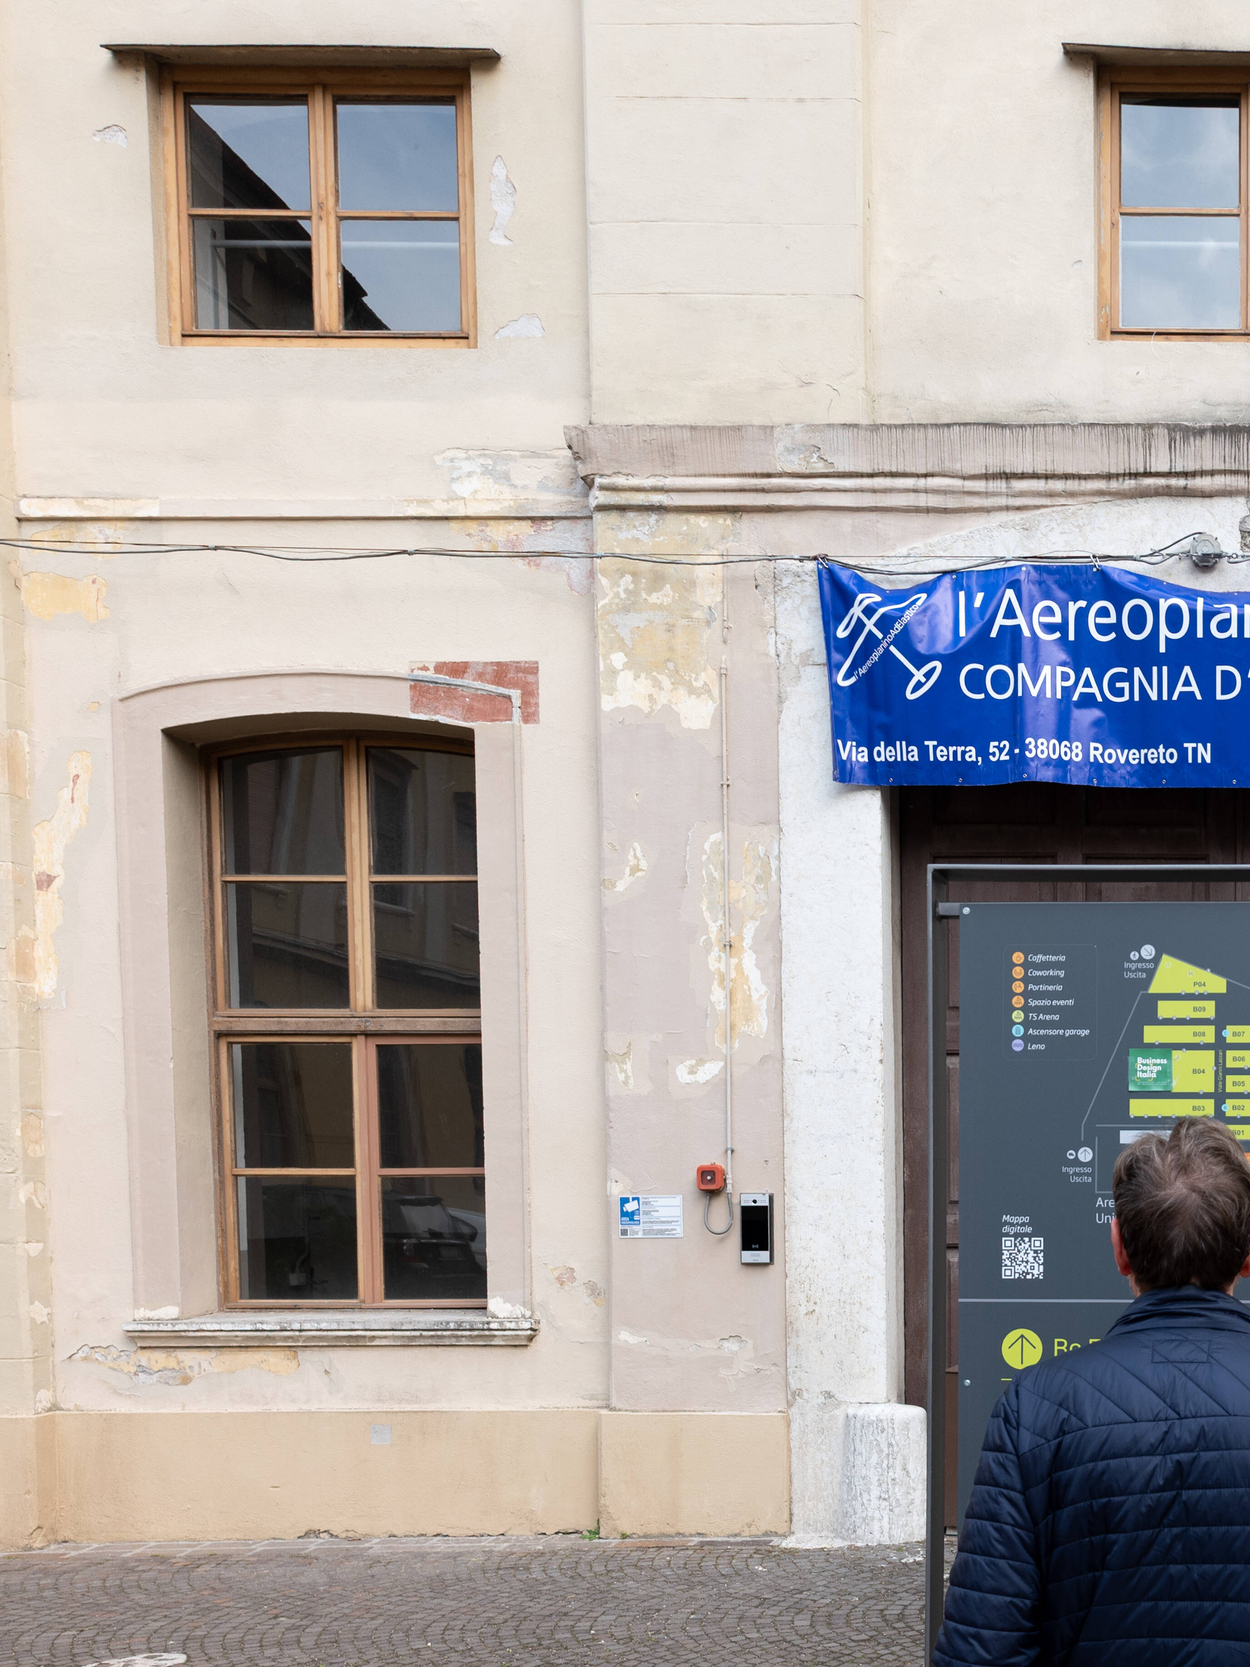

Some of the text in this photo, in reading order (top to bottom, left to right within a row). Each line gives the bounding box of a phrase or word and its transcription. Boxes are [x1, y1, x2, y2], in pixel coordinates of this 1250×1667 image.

[959, 663, 1202, 702] COMPAGNIA
[837, 740, 868, 762] Via
[873, 740, 919, 763] della
[924, 740, 982, 766] Terra,
[989, 740, 1010, 761] 52
[1025, 737, 1083, 762] 38068
[1089, 742, 1178, 764] Rovereto
[1183, 742, 1212, 764] TN
[1028, 953, 1066, 962] Caffetteria
[1124, 961, 1154, 970] Ingresso
[1028, 969, 1064, 978] Coworking
[1028, 983, 1062, 991] Portineria
[1028, 998, 1051, 1007] Spazio
[1028, 1013, 1060, 1021] TS Arena
[1028, 1028, 1090, 1037] Ascensore garage
[1137, 1064, 1162, 1073] Design
[1062, 1166, 1092, 1174] Ingresso
[1096, 1197, 1115, 1207] Are
[1002, 1215, 1030, 1224] Mappa
[1002, 1225, 1032, 1234] digitale
